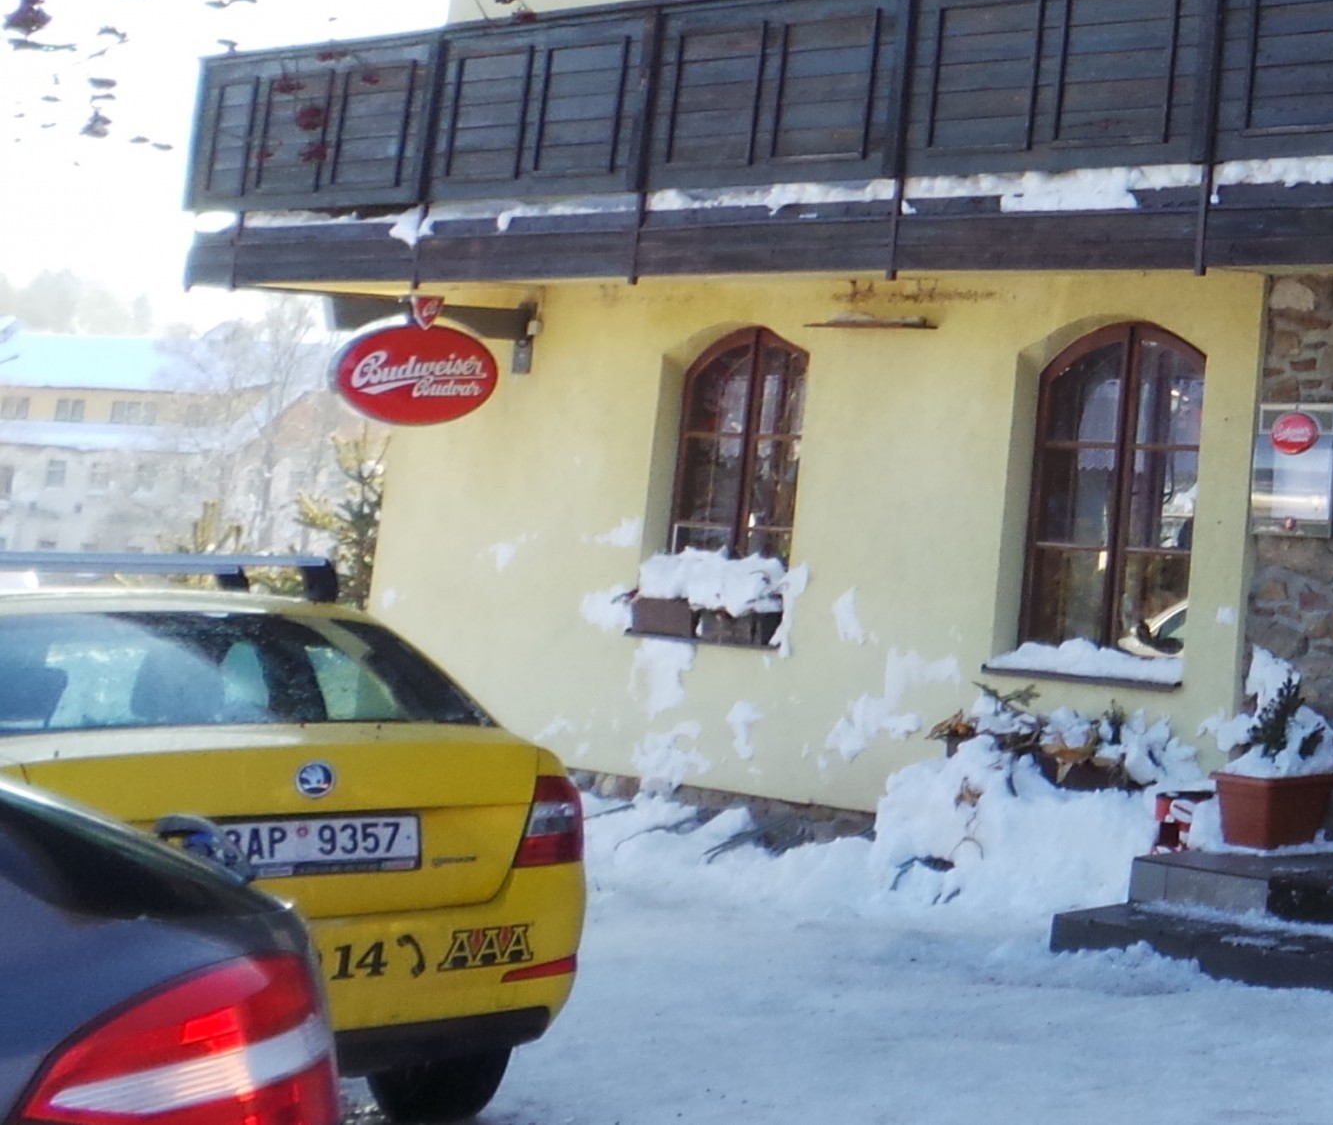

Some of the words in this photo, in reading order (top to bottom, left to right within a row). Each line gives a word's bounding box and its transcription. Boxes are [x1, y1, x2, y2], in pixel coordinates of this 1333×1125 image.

[352, 350, 487, 394] Budweiser
[412, 376, 481, 398] Budvar
[318, 823, 401, 856] 9357
[329, 941, 388, 981] 14
[437, 923, 533, 972] AAA
